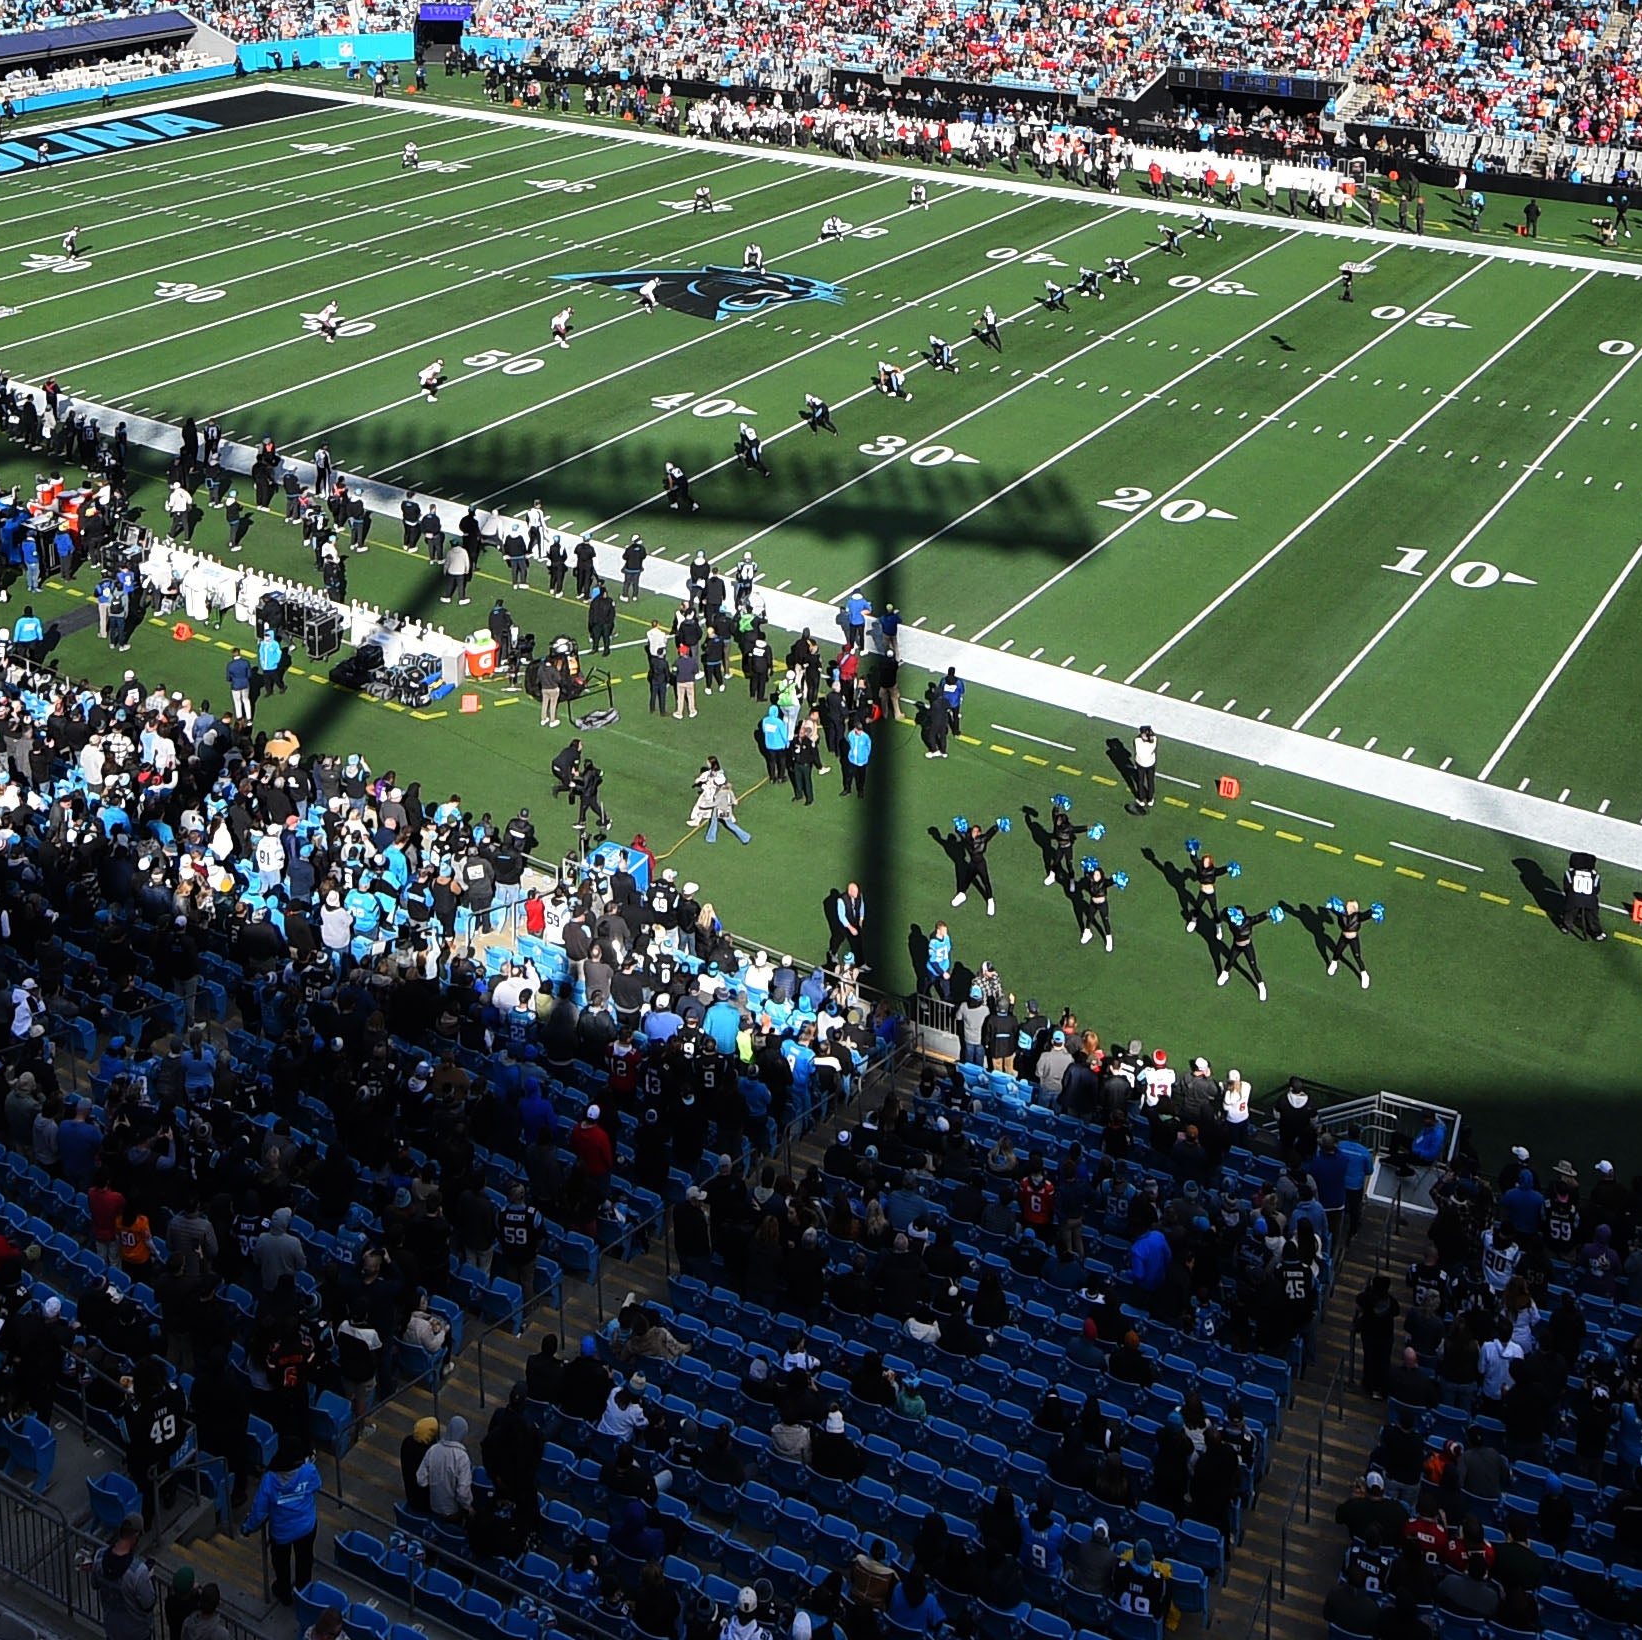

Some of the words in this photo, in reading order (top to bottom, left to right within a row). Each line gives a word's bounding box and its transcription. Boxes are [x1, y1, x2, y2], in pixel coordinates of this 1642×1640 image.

[534, 178, 596, 194] 30
[985, 246, 1062, 266] 40
[153, 281, 227, 304] 30
[1167, 274, 1246, 296] 30
[1370, 305, 1454, 327] 20
[463, 349, 545, 376] 50
[649, 392, 736, 418] 40
[858, 435, 956, 467] 30
[1096, 487, 1208, 523] 20
[1382, 545, 1500, 588] 10
[478, 652, 492, 669] G
[1223, 780, 1234, 794] 10
[652, 897, 668, 913] 49
[547, 911, 560, 928] 59
[610, 1057, 628, 1077] 12
[645, 1073, 662, 1095] 13
[703, 1071, 715, 1088] 9
[1149, 1082, 1169, 1098] 13
[1030, 1194, 1042, 1213] 6
[503, 1226, 528, 1246] 59
[1549, 1219, 1572, 1241] 59
[1285, 1279, 1306, 1300] 45
[150, 1412, 176, 1445] 49
[1031, 1543, 1047, 1569] 9
